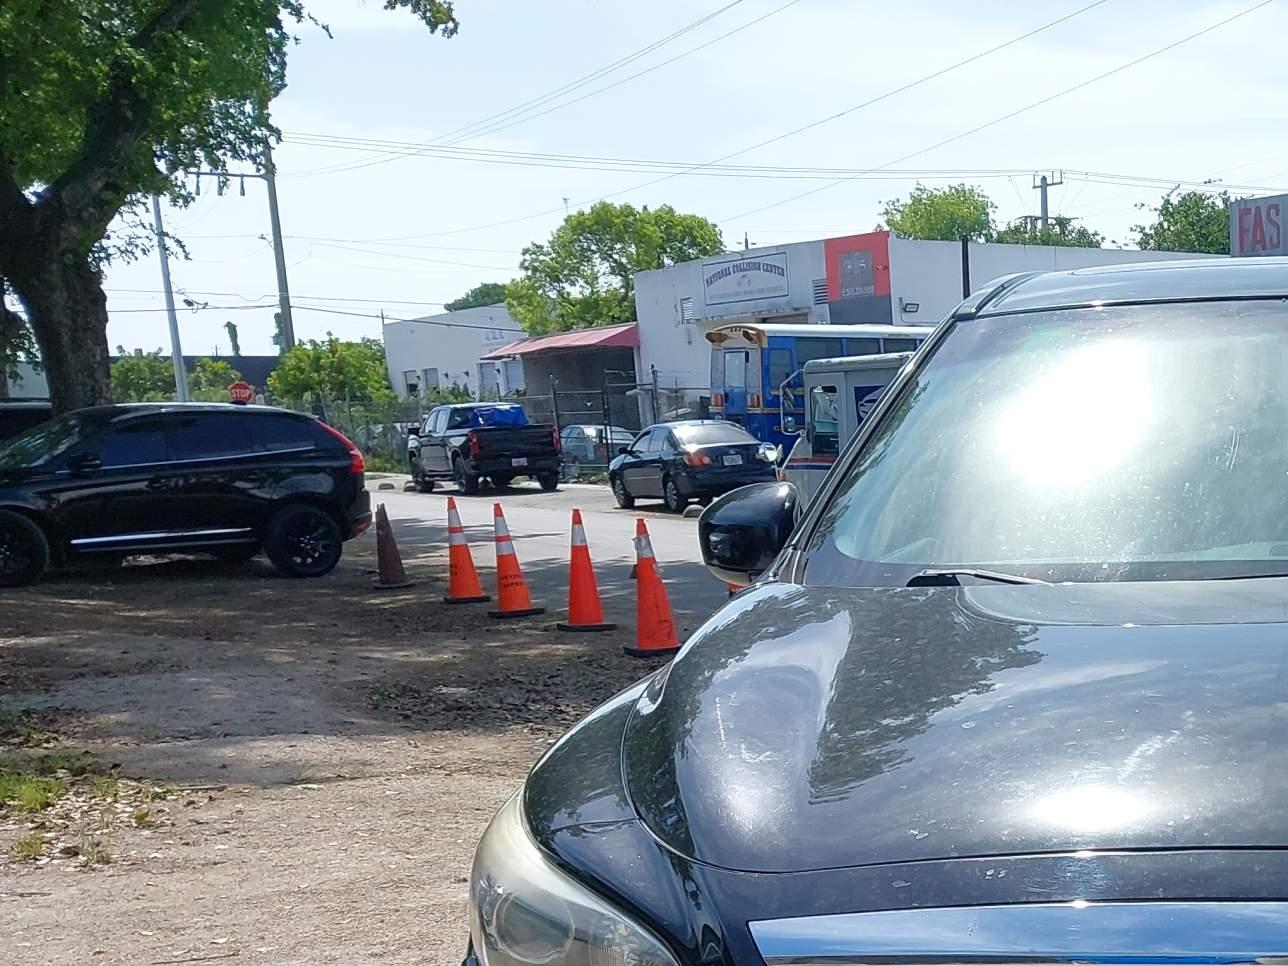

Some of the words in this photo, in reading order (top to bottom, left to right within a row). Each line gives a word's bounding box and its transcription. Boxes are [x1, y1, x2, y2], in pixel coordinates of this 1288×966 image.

[1238, 204, 1280, 253] FAS
[705, 266, 731, 288] NATIONAL
[732, 261, 761, 274] COLLISION
[762, 262, 785, 277] CENTER
[231, 389, 251, 399] STOP
